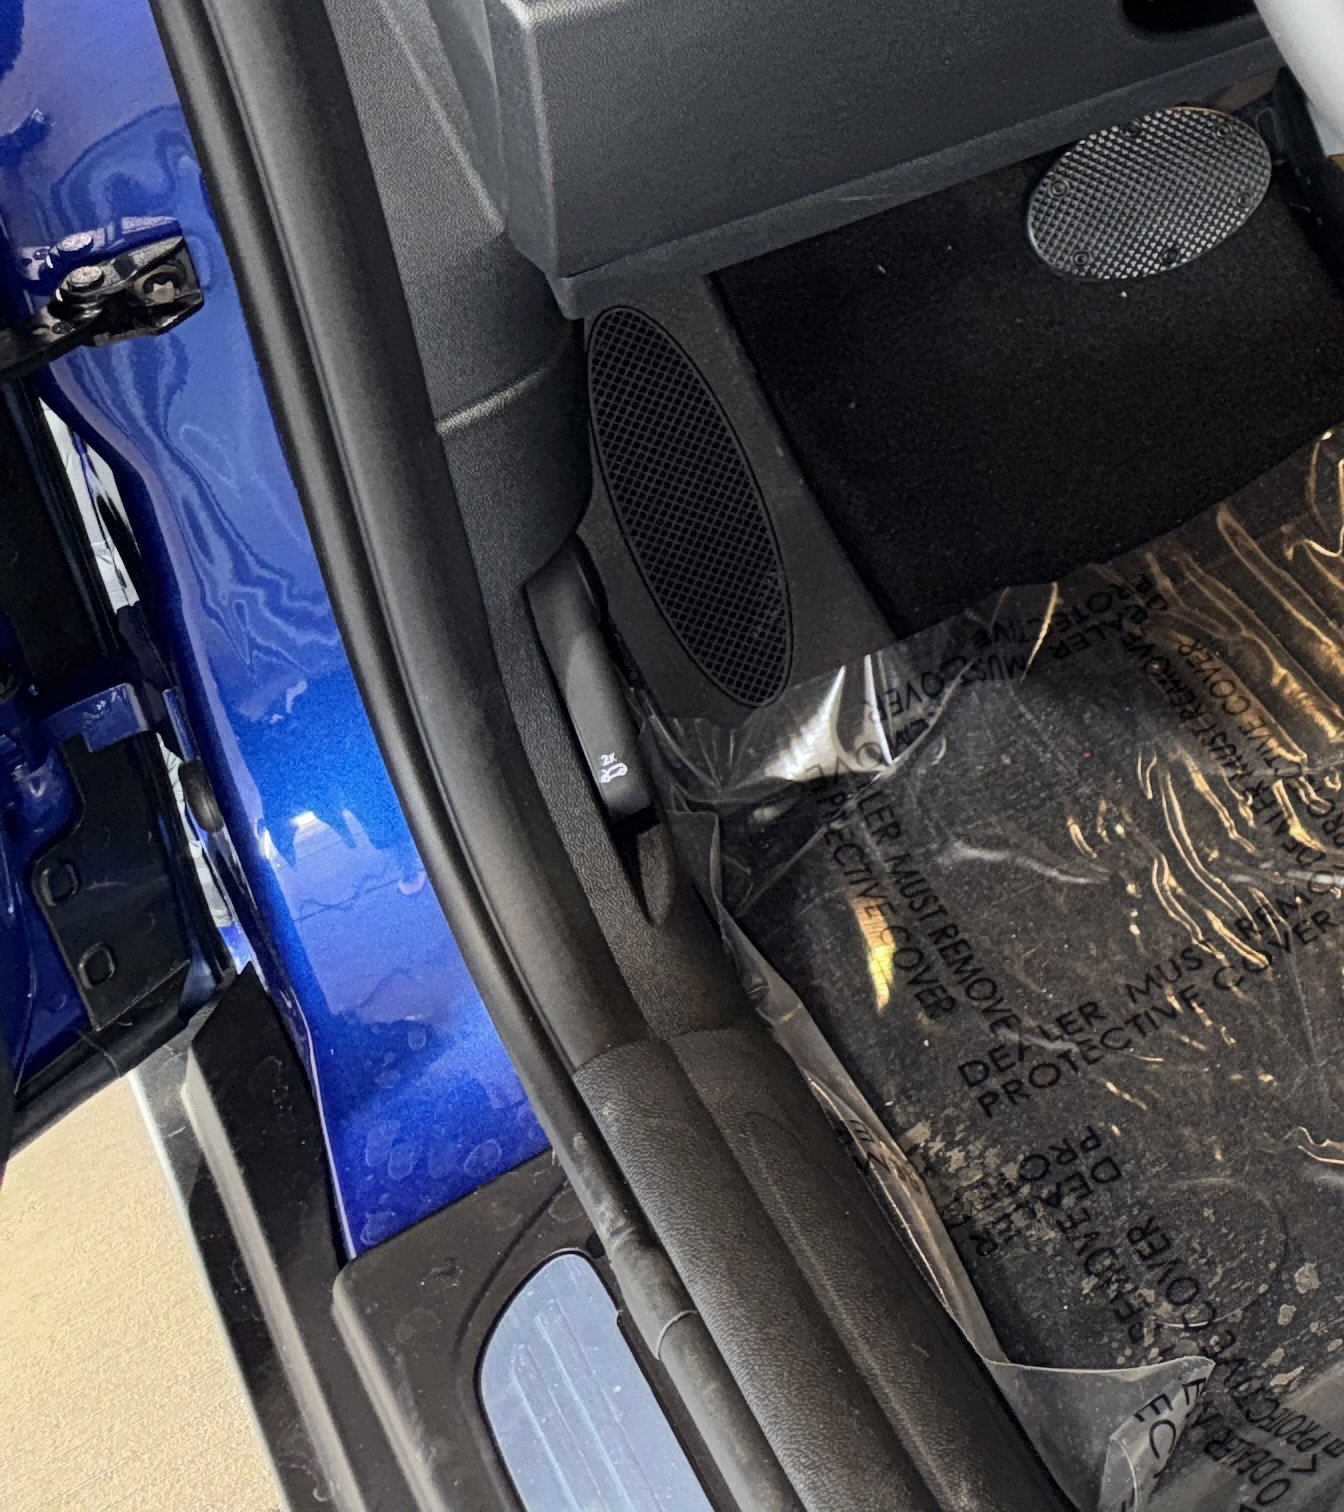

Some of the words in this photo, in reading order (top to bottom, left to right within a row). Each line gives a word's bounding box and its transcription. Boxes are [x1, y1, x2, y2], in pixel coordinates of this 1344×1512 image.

[878, 925, 958, 1021] COVER
[927, 922, 1023, 1036] REMOVE
[977, 984, 1208, 1119] PROTECTIVE
